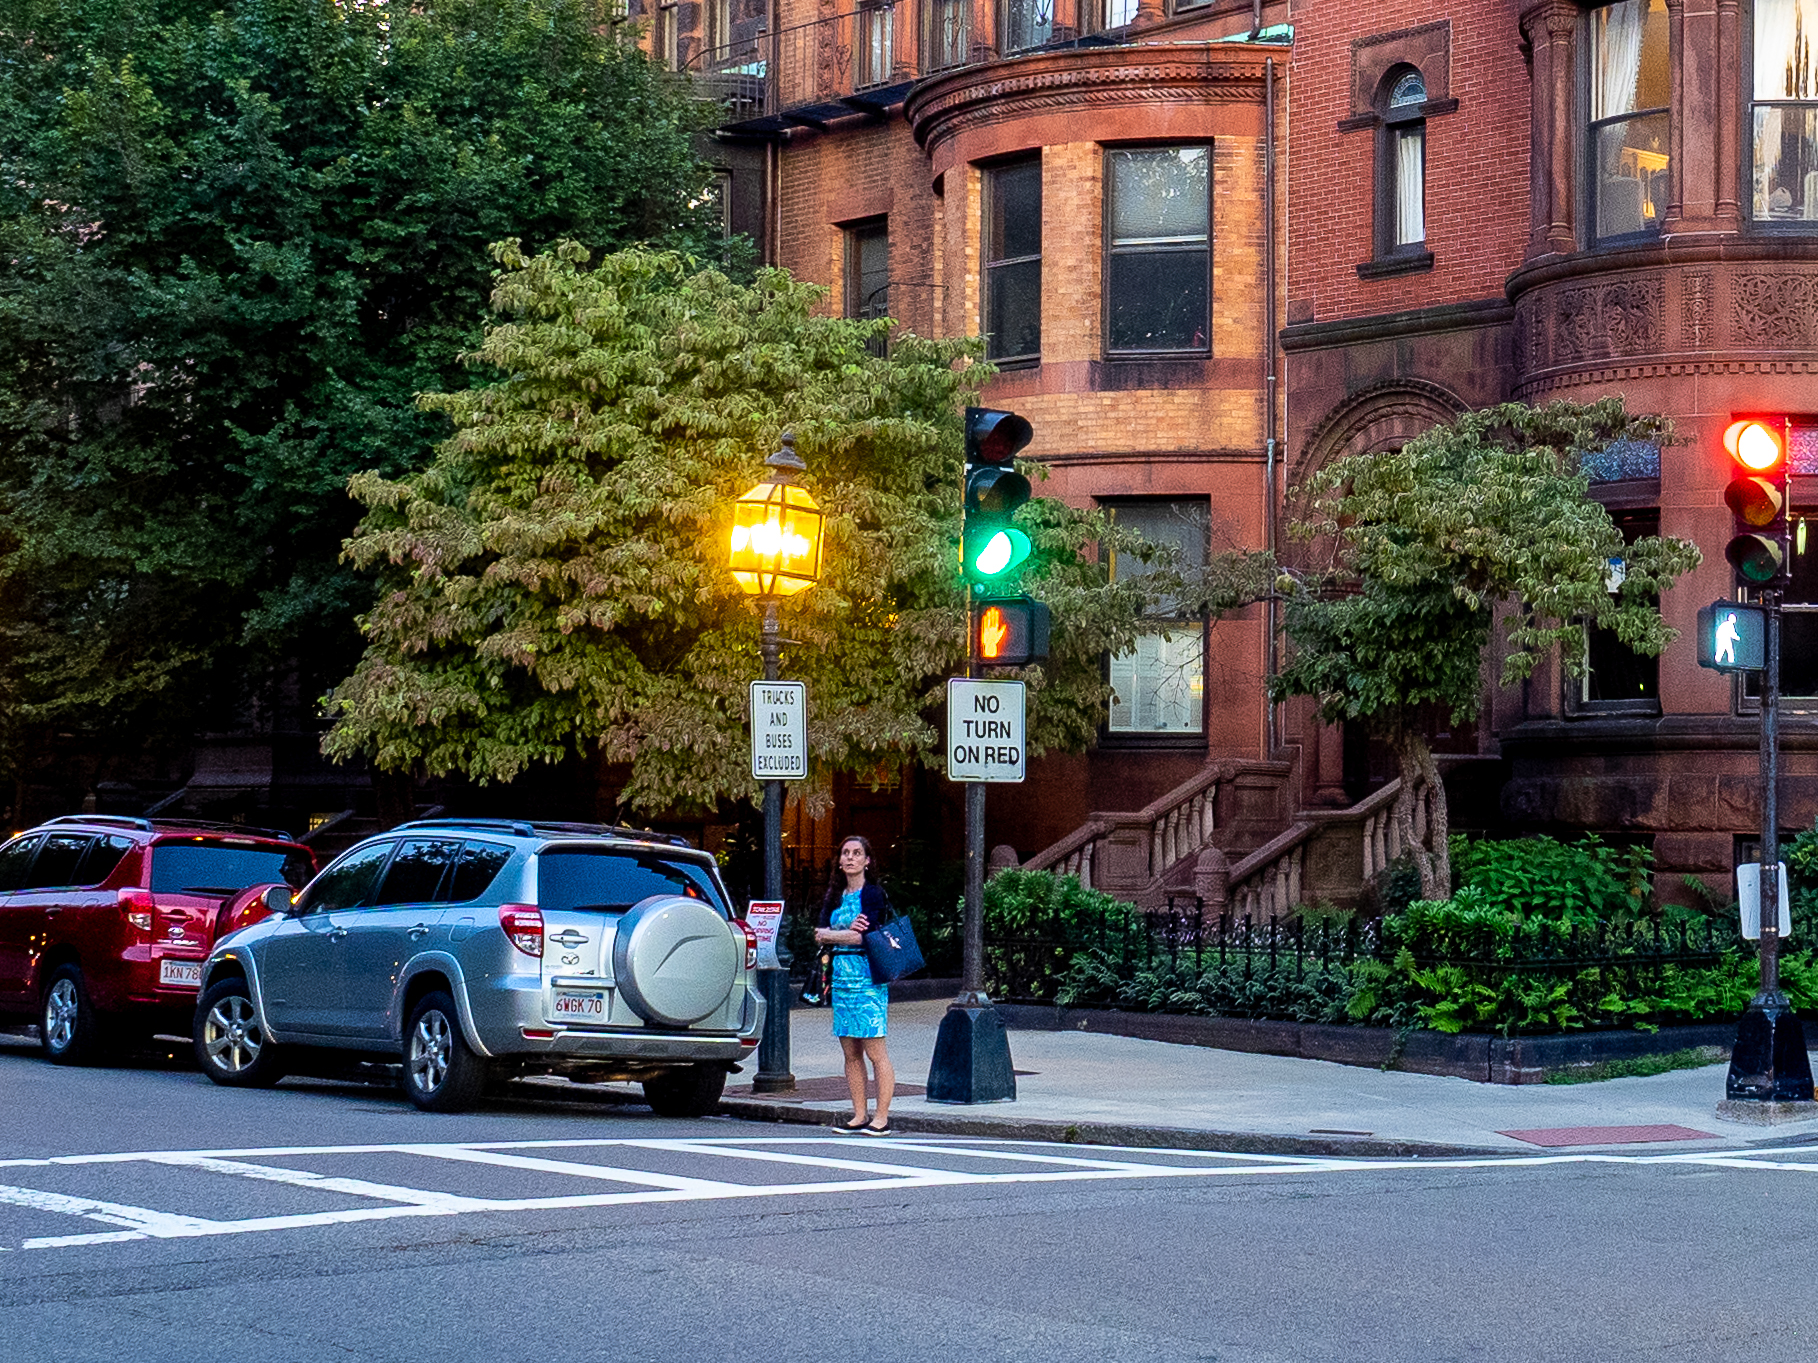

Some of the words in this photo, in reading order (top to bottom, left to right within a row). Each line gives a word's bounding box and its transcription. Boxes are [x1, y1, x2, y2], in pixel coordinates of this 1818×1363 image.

[762, 690, 795, 705] TRUCKS
[974, 695, 1000, 713] NO
[769, 712, 788, 726] AND
[963, 720, 1011, 739] TURN
[766, 734, 793, 748] BUSES
[758, 755, 801, 770] EXCLUDED
[954, 745, 980, 764] ON
[984, 746, 1020, 765] RED
[555, 997, 584, 1013] 6WGK
[588, 998, 603, 1014] 70
